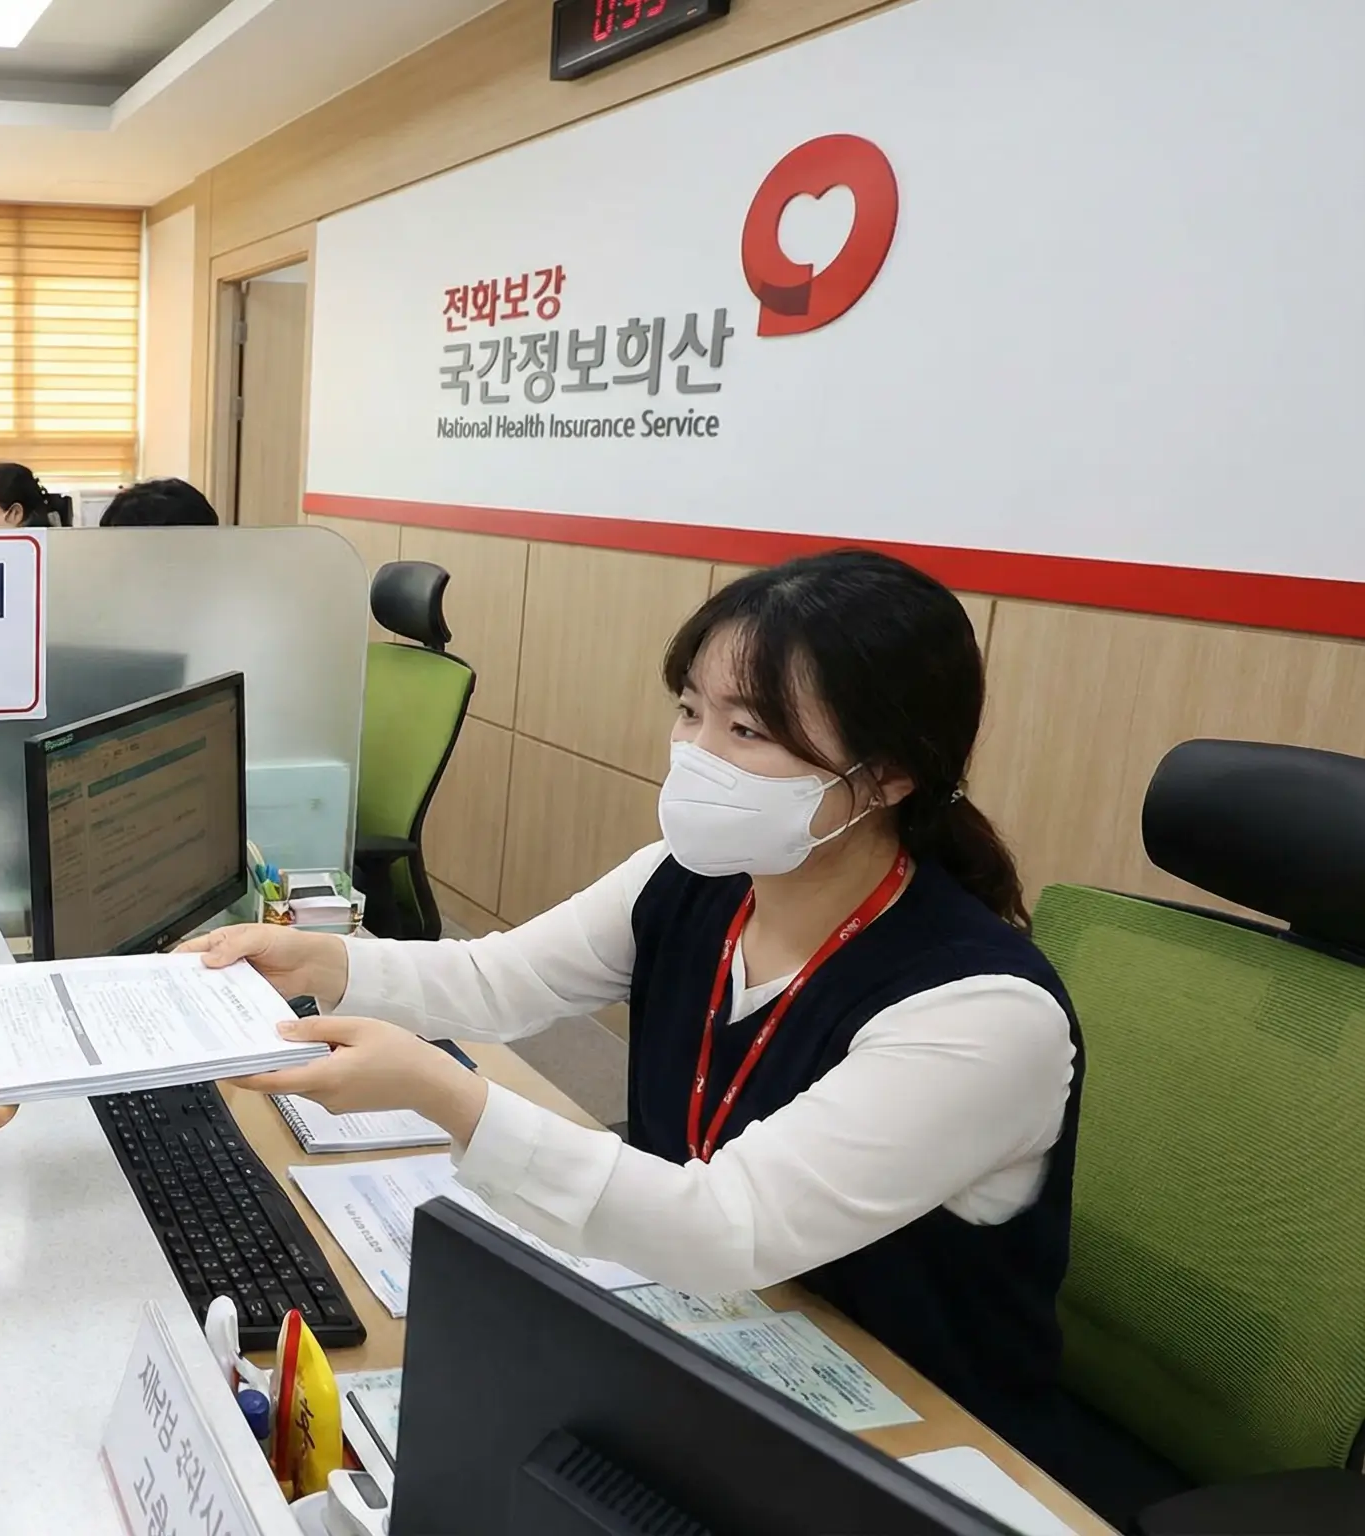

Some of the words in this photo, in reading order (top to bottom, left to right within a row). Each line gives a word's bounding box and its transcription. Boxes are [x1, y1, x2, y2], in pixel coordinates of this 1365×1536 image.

[443, 264, 566, 332] 전화보강
[439, 307, 735, 406] 국간정보희산
[438, 414, 492, 438] National
[495, 413, 545, 438] Health
[549, 411, 635, 438] Insurance
[640, 408, 720, 438] Service
